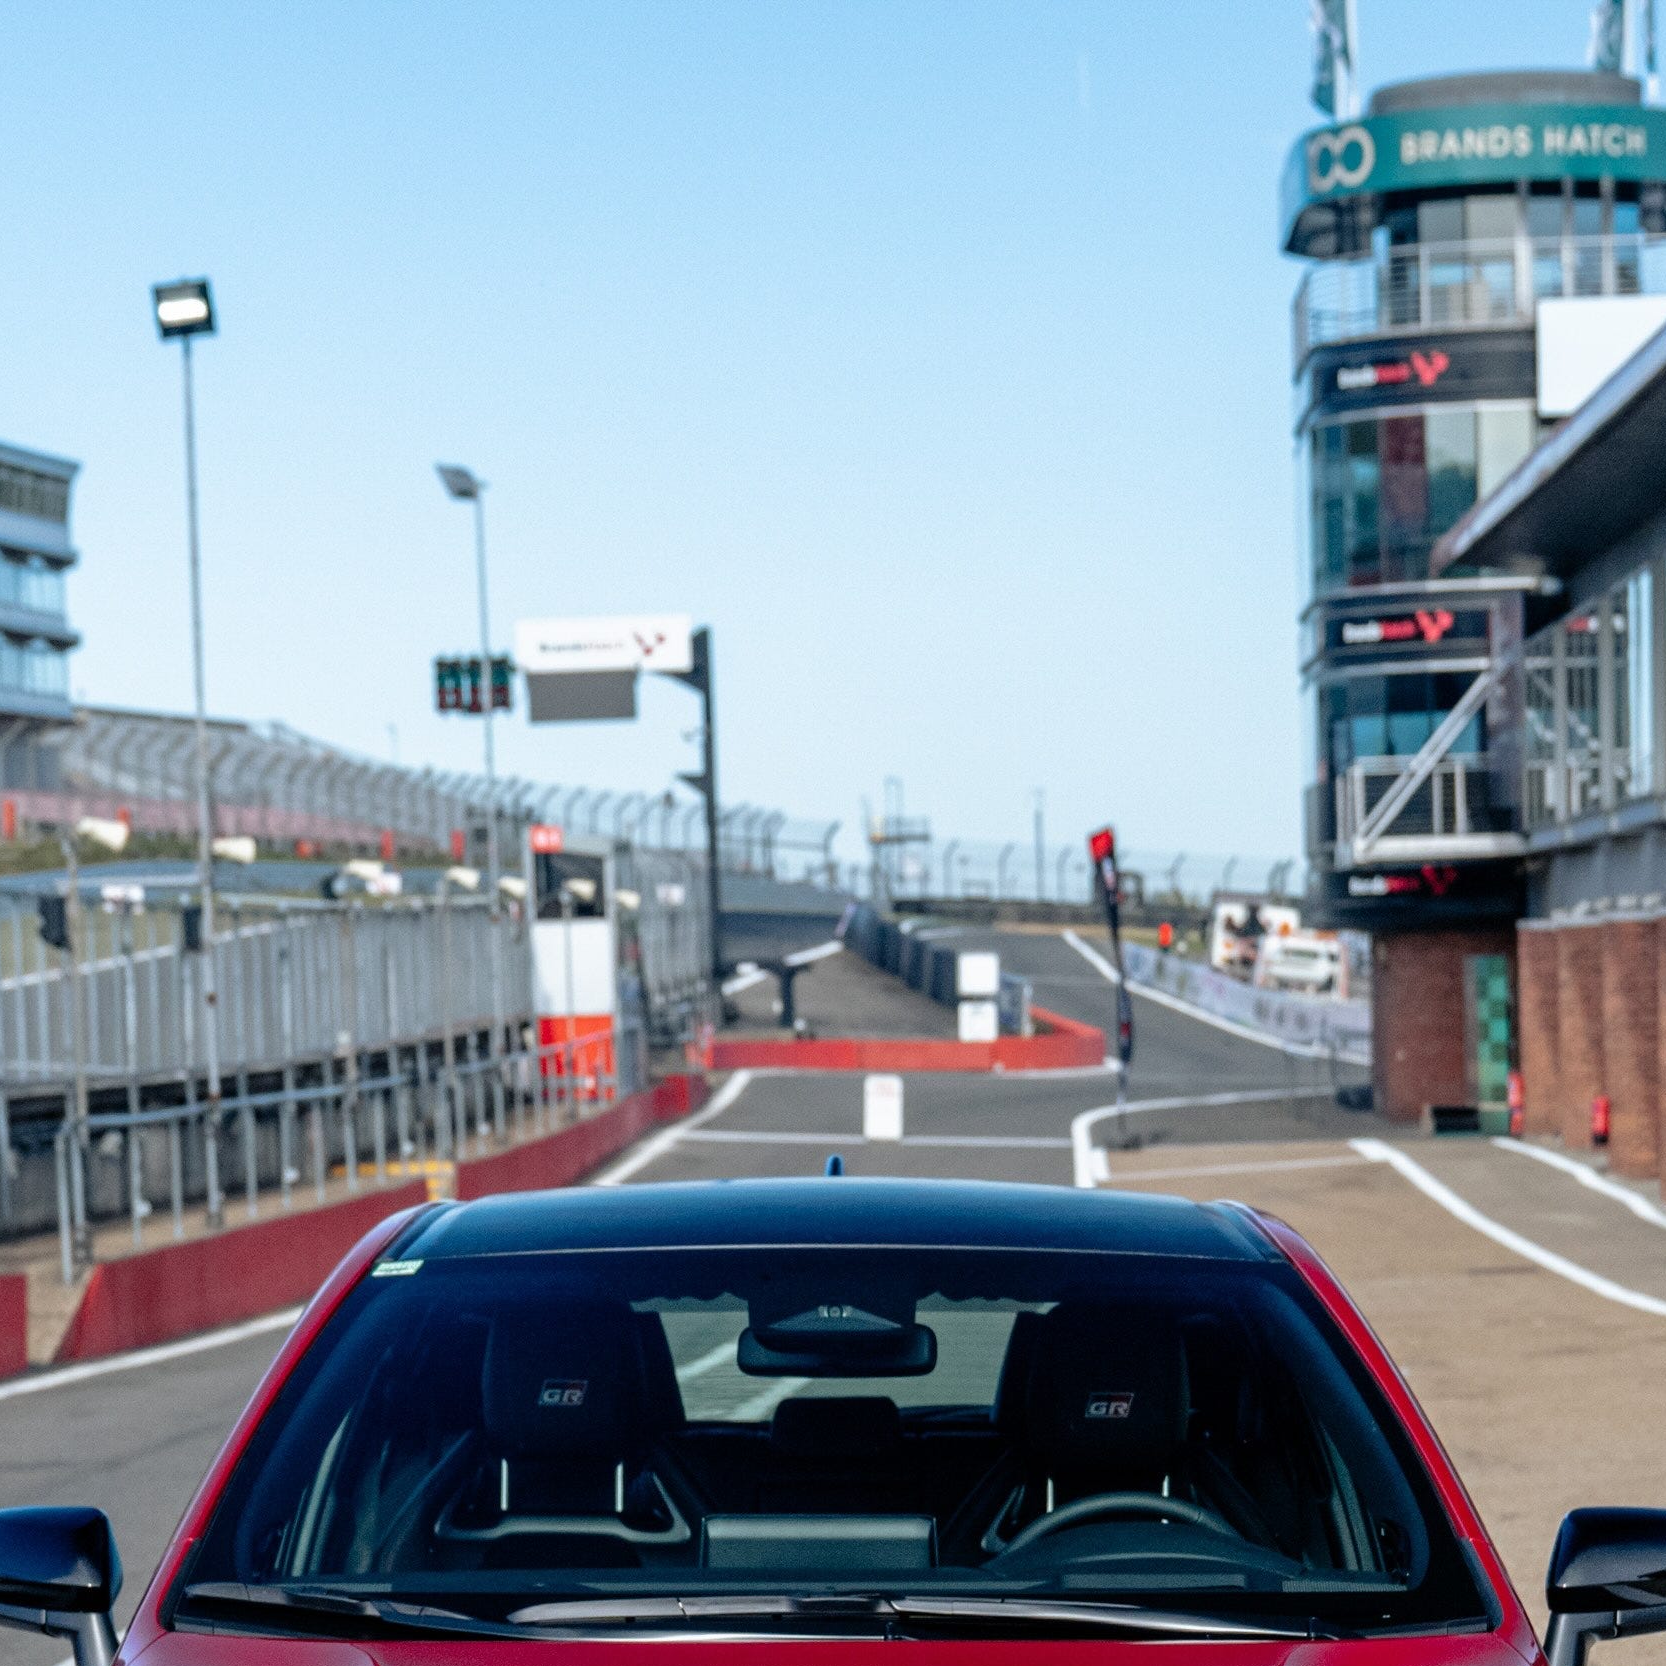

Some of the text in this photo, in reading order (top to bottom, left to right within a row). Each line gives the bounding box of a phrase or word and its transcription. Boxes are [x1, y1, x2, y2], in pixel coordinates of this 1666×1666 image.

[1400, 124, 1532, 165] BRANDS
[1543, 123, 1647, 158] HATCH
[542, 1389, 584, 1406] GR
[1089, 1401, 1130, 1418] GR
